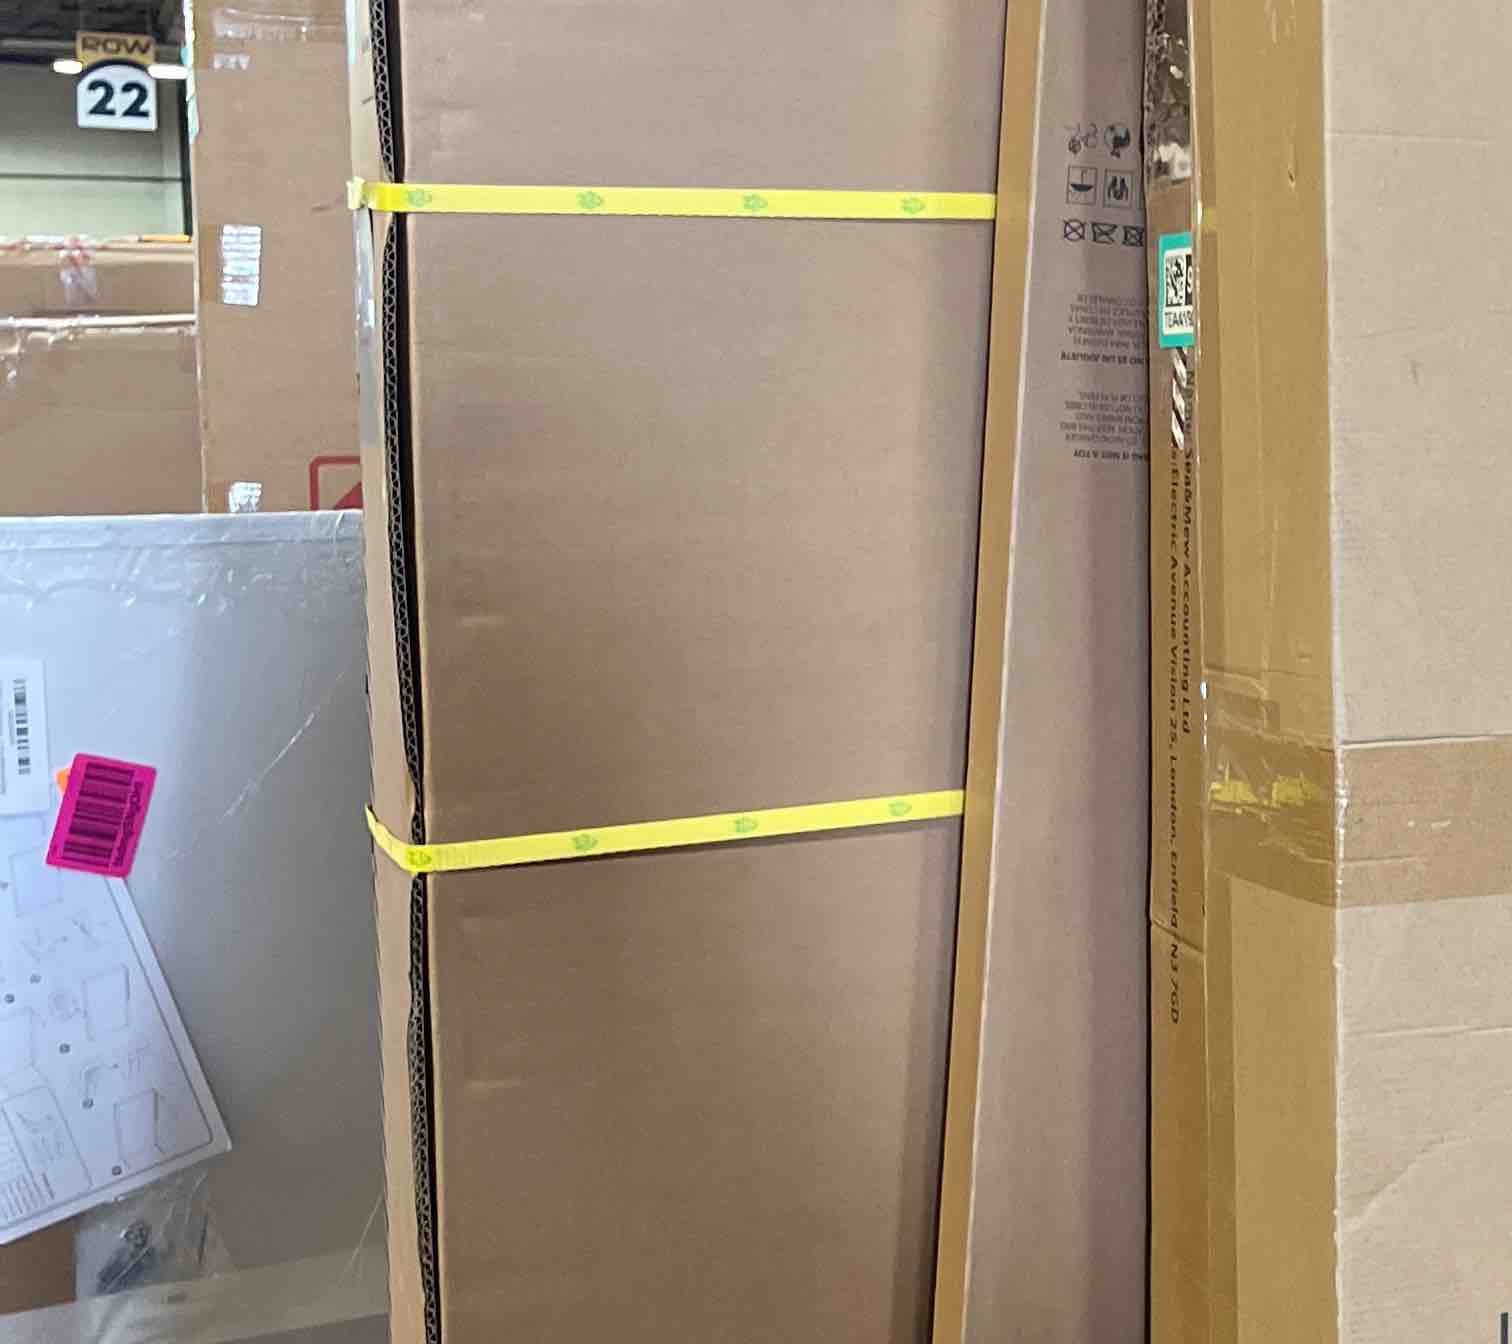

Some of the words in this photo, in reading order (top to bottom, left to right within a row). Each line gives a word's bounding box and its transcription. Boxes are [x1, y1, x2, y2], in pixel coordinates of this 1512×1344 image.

[81, 36, 155, 57] ROW
[85, 79, 151, 120] 22
[1170, 556, 1178, 641] Avenue
[1182, 564, 1191, 692] Accounting
[1170, 646, 1178, 711] Vision
[1182, 698, 1191, 735] Ltd
